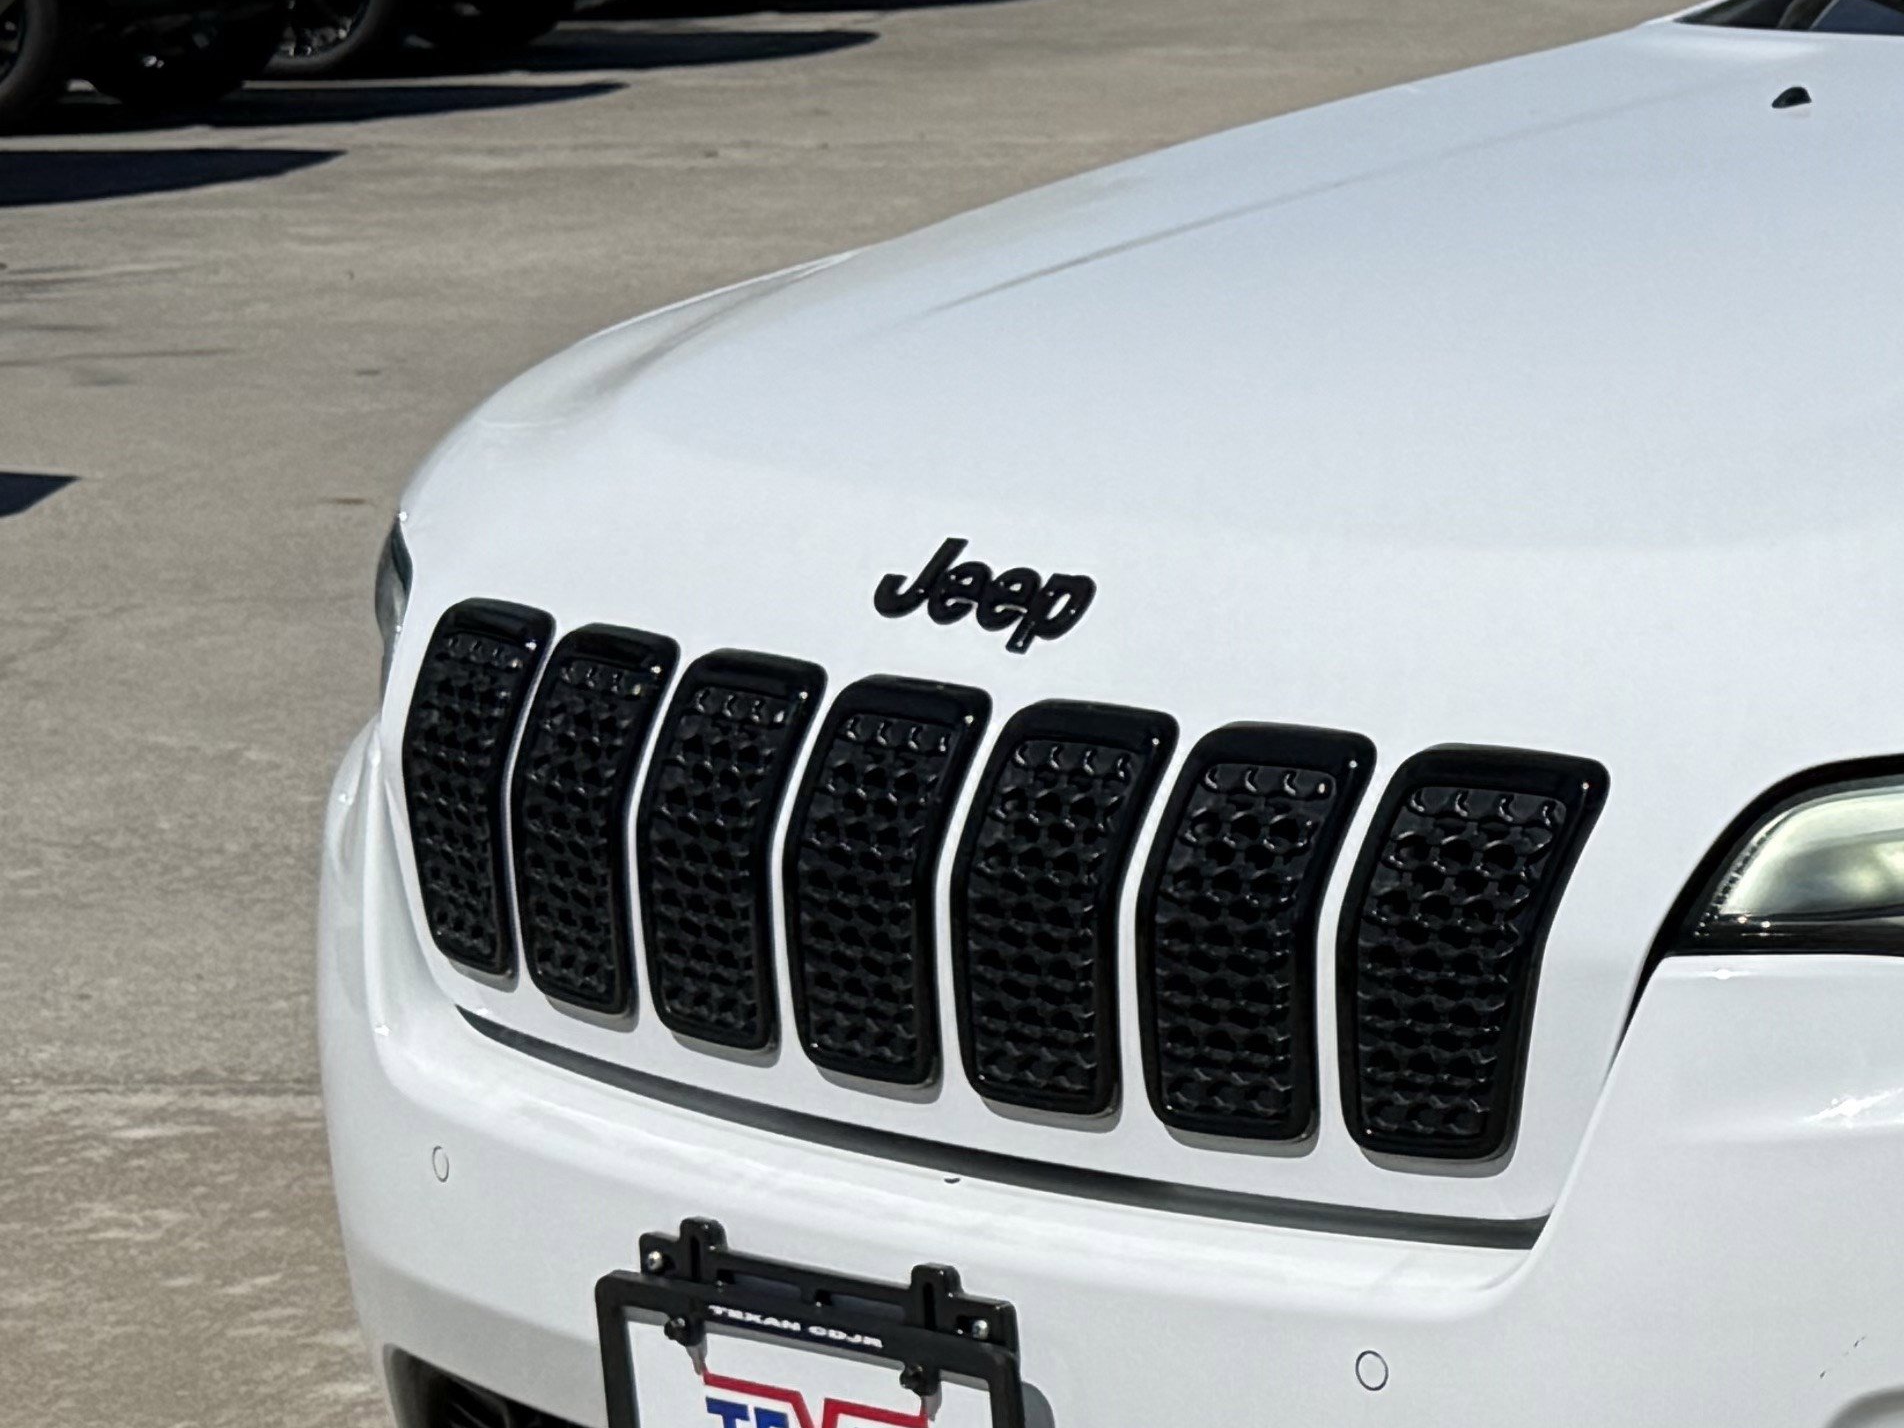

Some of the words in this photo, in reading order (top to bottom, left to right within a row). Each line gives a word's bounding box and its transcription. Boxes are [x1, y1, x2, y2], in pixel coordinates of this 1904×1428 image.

[874, 537, 1097, 654] Jeep
[708, 1305, 801, 1332] TEXAN
[808, 1325, 883, 1349] CDJR
